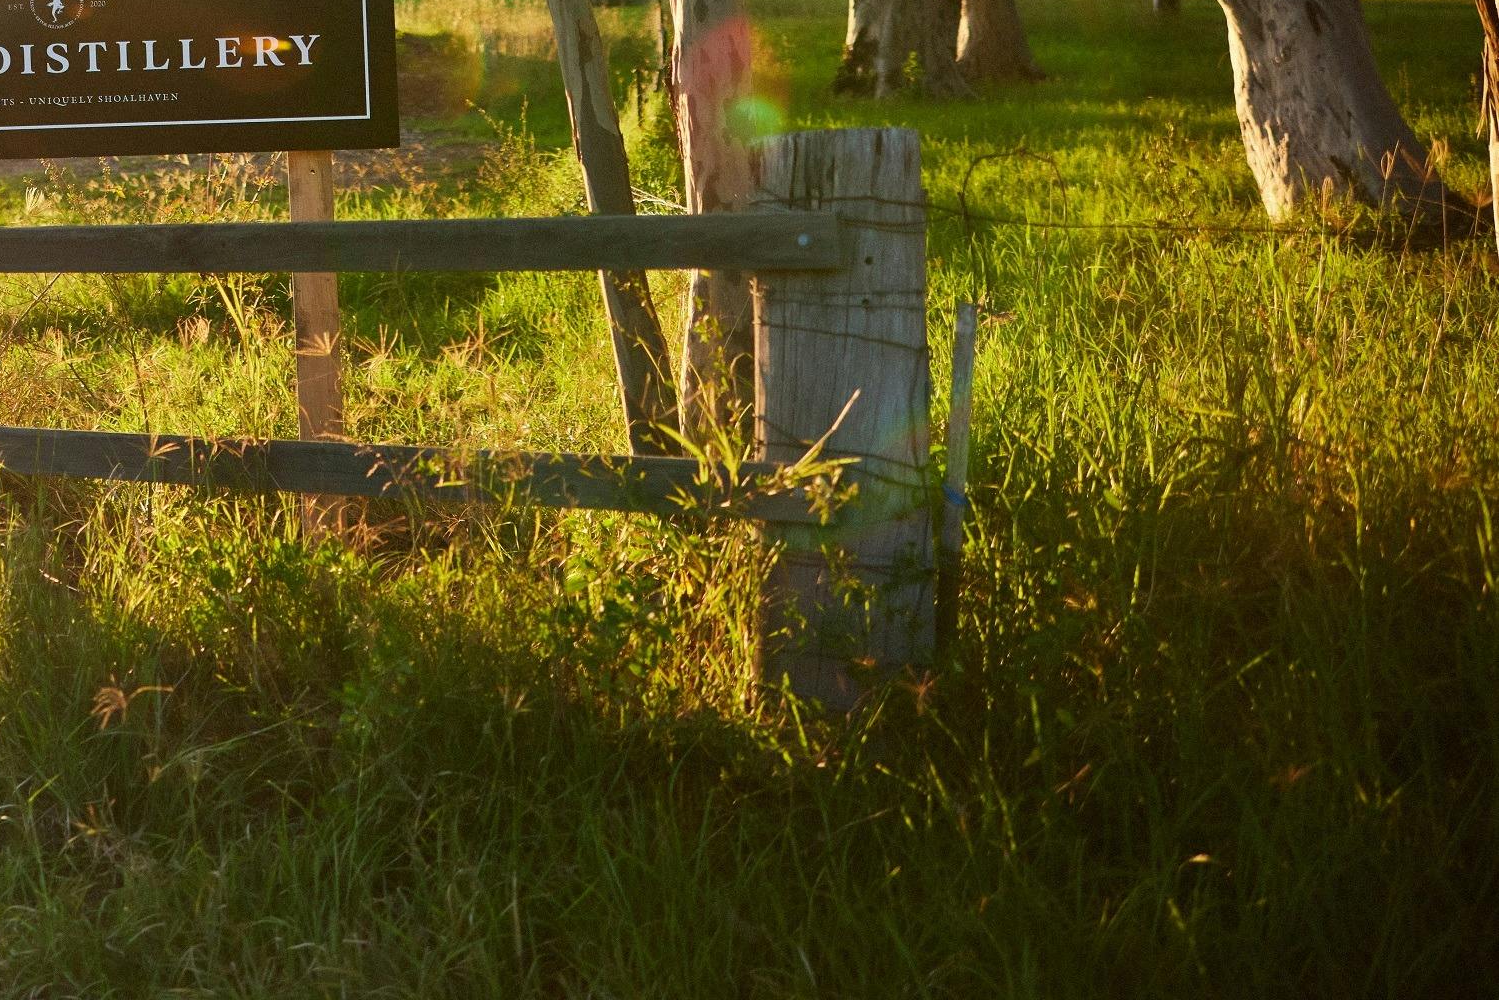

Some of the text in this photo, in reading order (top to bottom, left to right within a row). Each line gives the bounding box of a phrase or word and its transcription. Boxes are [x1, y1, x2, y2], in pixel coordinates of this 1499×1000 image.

[89, 0, 106, 8] 2020
[29, 95, 94, 107] UNIQUELY
[98, 92, 179, 104] SHOALHAVEN
